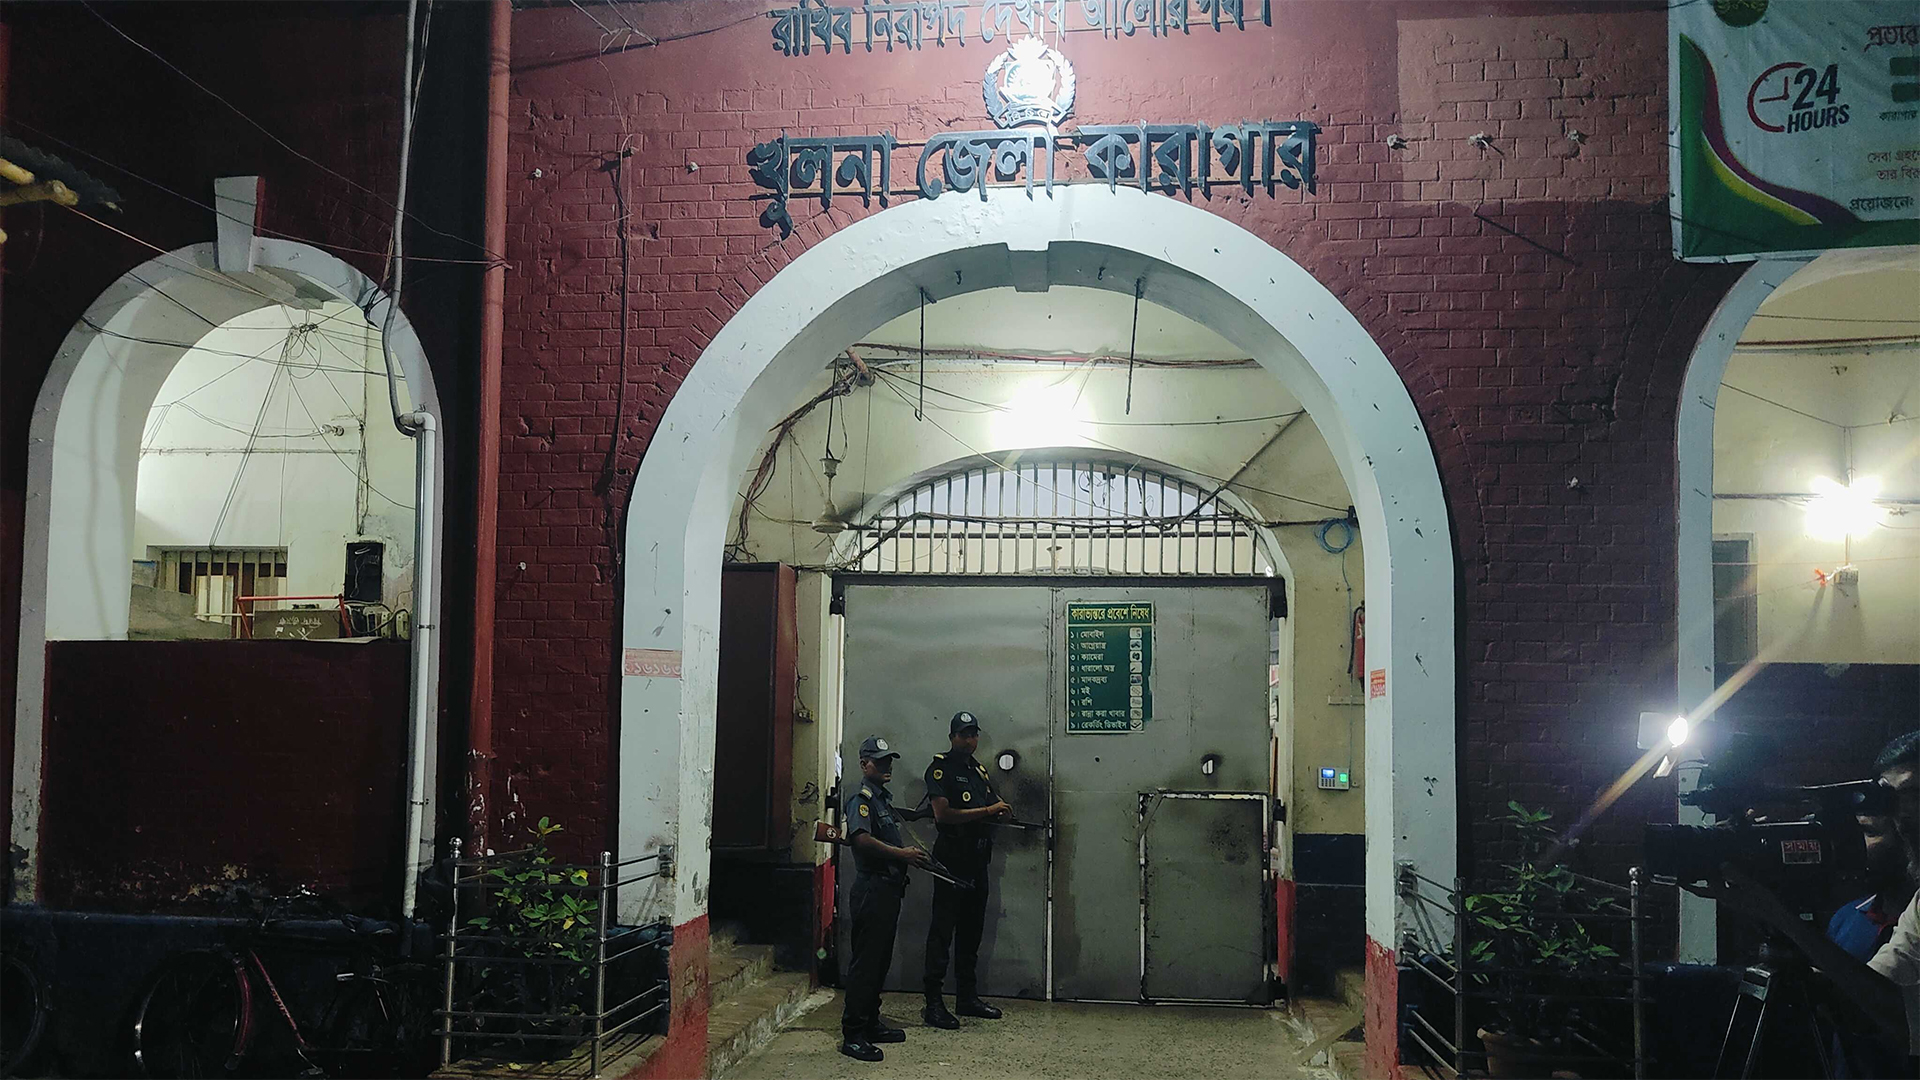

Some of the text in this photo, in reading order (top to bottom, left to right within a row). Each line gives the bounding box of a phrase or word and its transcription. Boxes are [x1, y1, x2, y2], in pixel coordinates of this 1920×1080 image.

[771, 0, 857, 57] রাখিব
[863, 0, 969, 52] নিরাপদ
[1792, 63, 1841, 111] 24
[1786, 103, 1850, 134] HOURS
[748, 120, 1322, 240] খুলনা জেলা কারাগার
[1130, 603, 1150, 620] নিষেধ
[1080, 630, 1105, 639] মোবাইল
